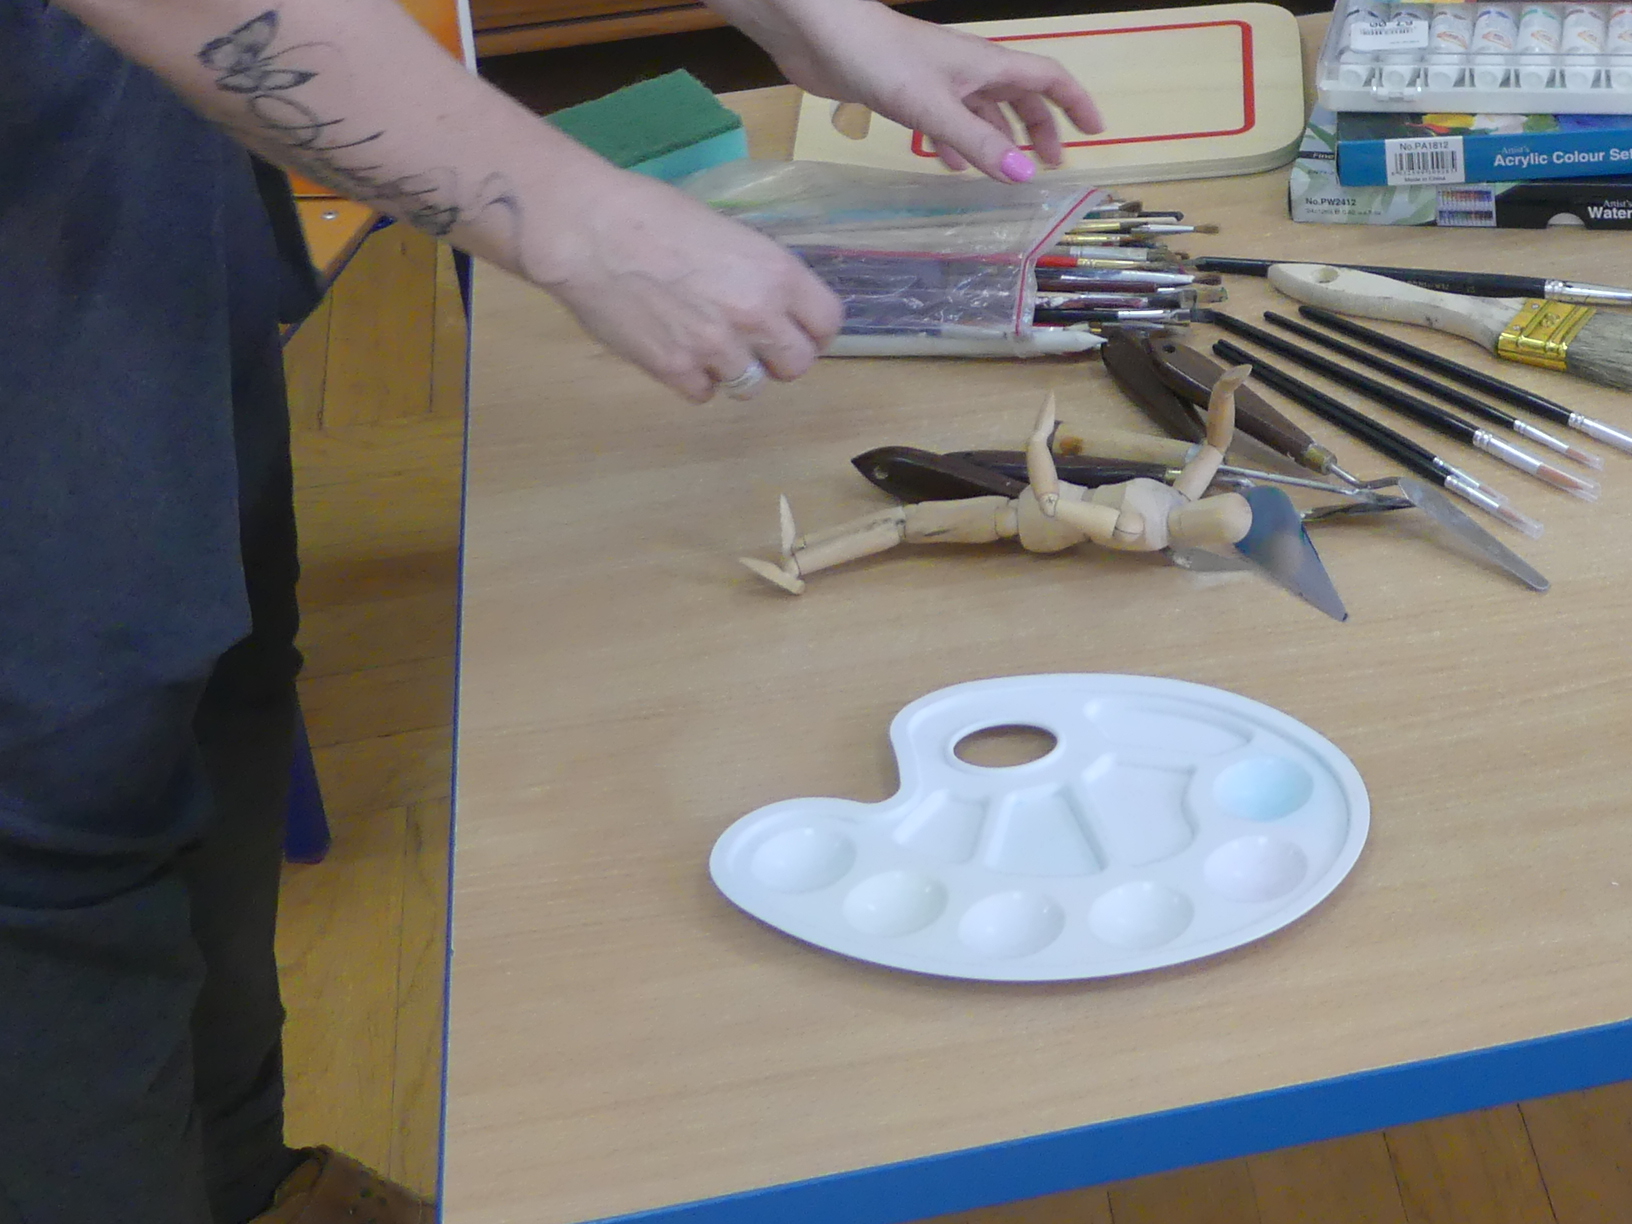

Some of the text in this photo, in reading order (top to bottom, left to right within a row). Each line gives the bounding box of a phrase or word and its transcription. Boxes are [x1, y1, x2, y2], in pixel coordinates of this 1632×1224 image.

[1400, 141, 1449, 151] No.PA1812
[1494, 154, 1548, 168] Acrylic
[1553, 151, 1605, 163] Colour
[1305, 197, 1357, 207] No.PW2412
